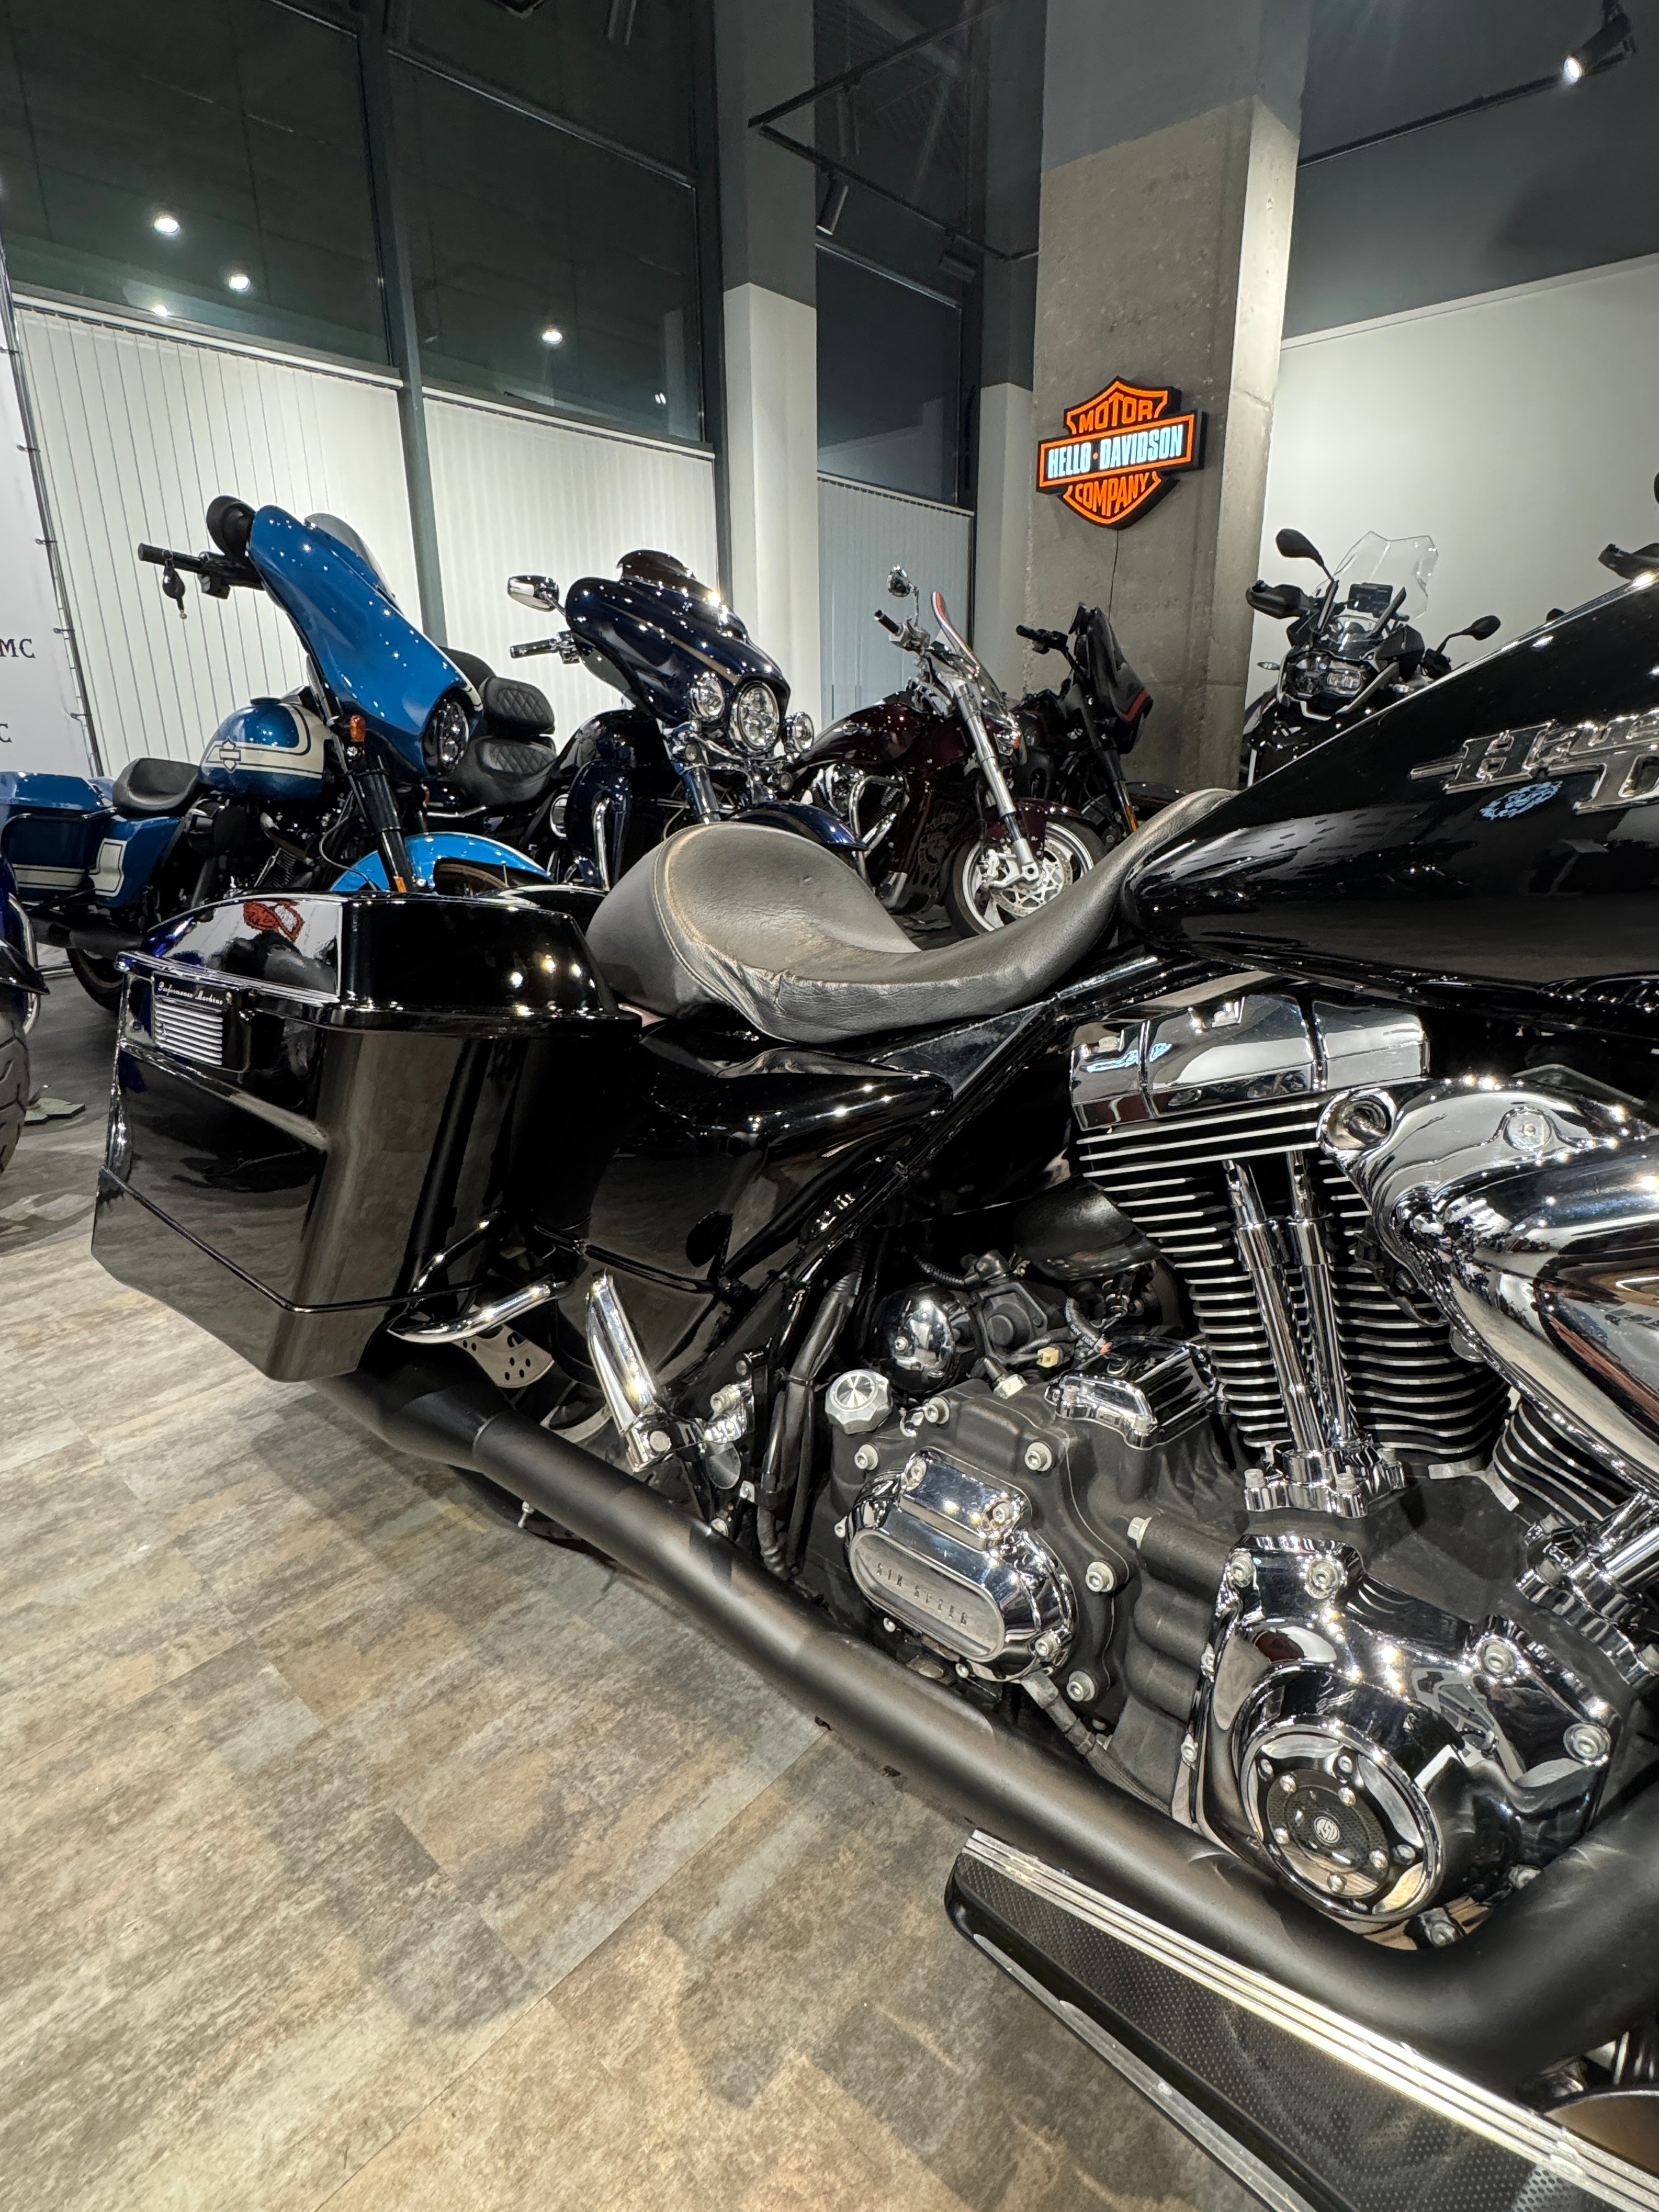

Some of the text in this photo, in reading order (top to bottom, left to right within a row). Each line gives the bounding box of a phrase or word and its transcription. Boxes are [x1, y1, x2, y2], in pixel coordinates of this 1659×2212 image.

[1078, 391, 1154, 434] MOTOR
[1074, 472, 1150, 517] COMPANY
[877, 1563, 903, 1587] SIX
